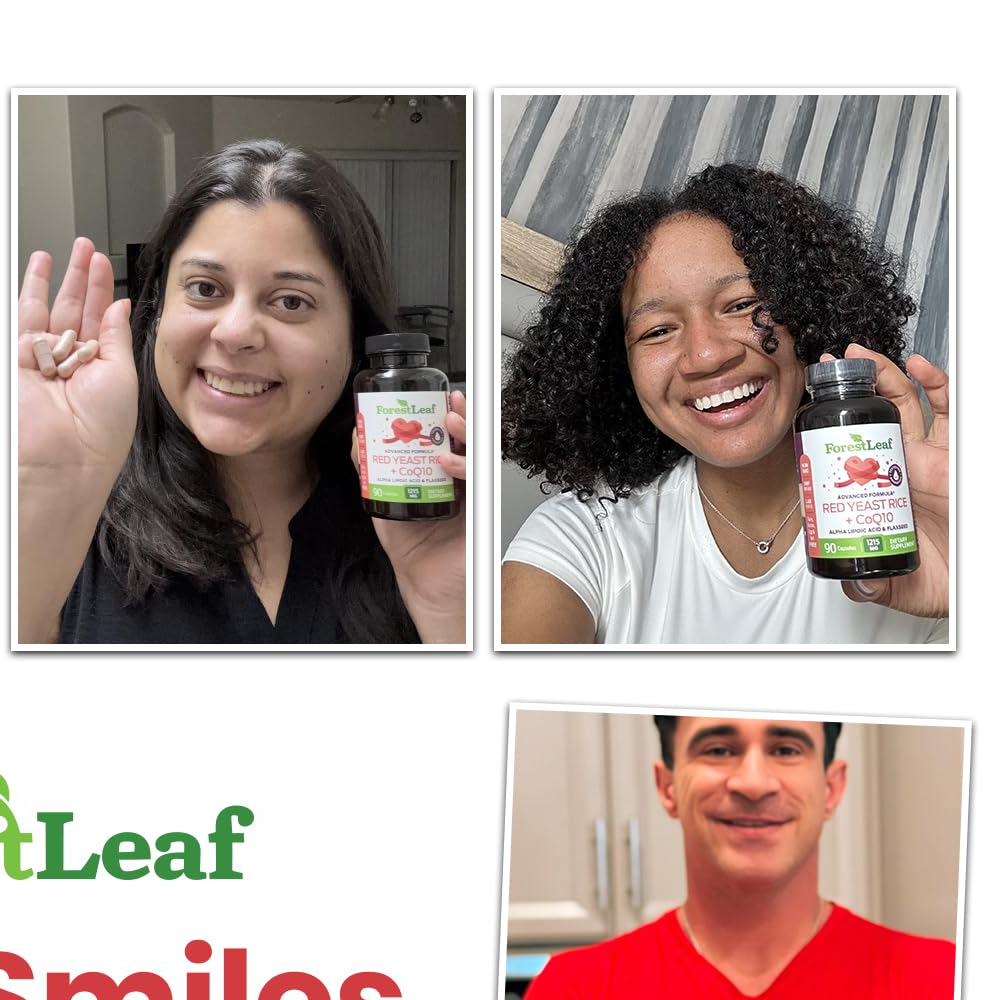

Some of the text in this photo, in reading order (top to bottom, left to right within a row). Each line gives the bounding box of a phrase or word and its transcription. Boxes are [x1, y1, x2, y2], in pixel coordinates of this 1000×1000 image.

[376, 404, 436, 415] ForestLeaf
[825, 438, 893, 454] ForestLeaf
[373, 456, 441, 465] RED YEAST RIC
[399, 467, 433, 477] CoQ10
[373, 487, 383, 497] 90
[823, 497, 907, 514] RED YEAST RICE
[846, 512, 894, 526] + CoQ10
[824, 543, 837, 554] 90
